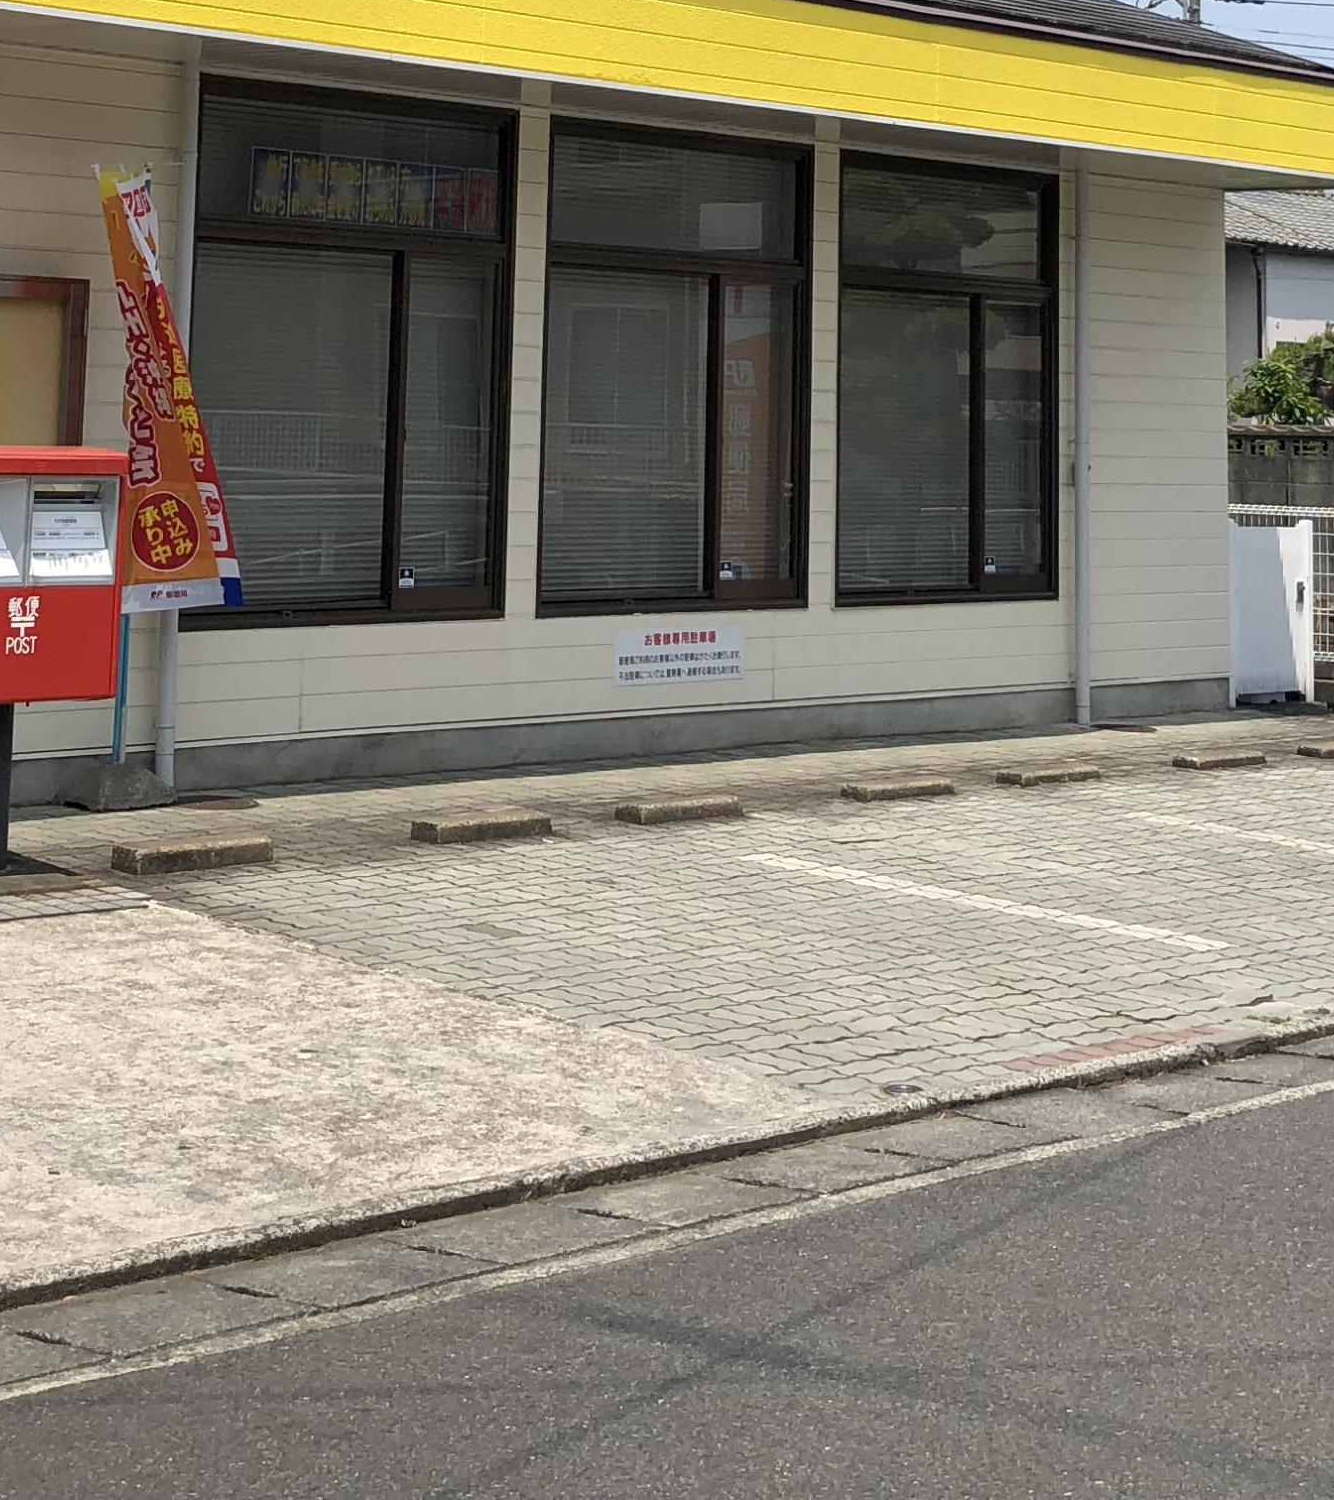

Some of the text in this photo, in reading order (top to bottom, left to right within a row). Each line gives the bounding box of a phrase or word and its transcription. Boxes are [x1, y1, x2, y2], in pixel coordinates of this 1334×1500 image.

[138, 505, 173, 565] 承り中
[160, 499, 194, 557] 申込み
[8, 596, 40, 618] 郵便
[5, 636, 38, 655] POST
[644, 631, 717, 646] お客様専用駐車場
